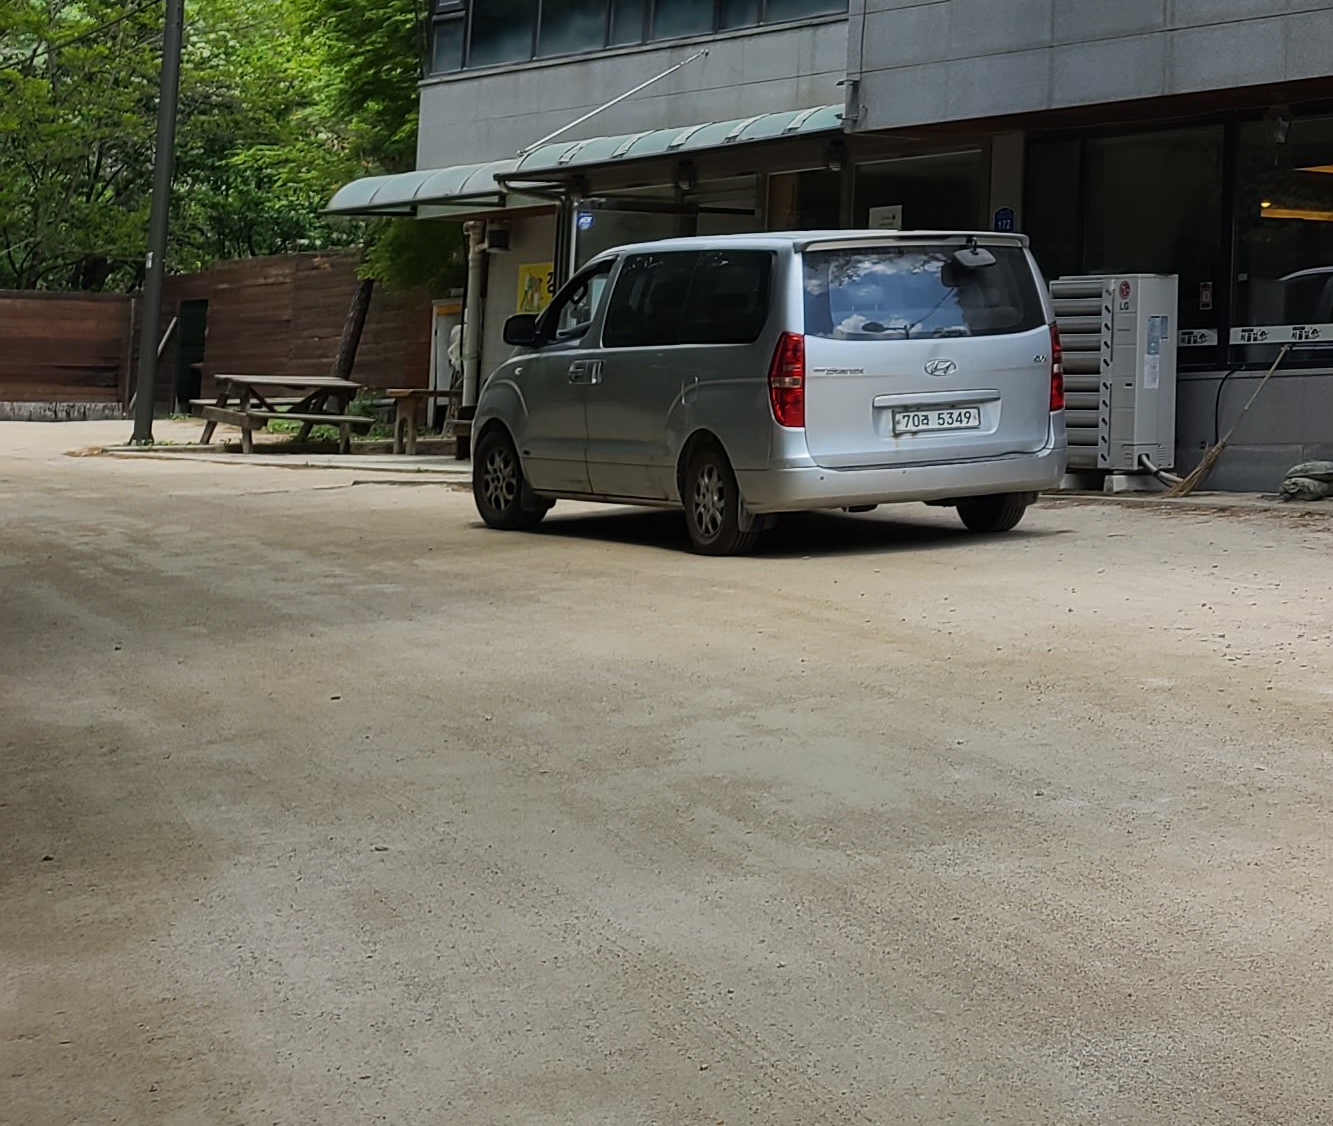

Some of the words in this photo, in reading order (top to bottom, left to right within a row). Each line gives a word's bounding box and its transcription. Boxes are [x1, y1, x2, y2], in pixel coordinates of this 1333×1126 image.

[997, 219, 1011, 230] 172
[1119, 301, 1130, 311] LG
[936, 410, 973, 427] 5349
